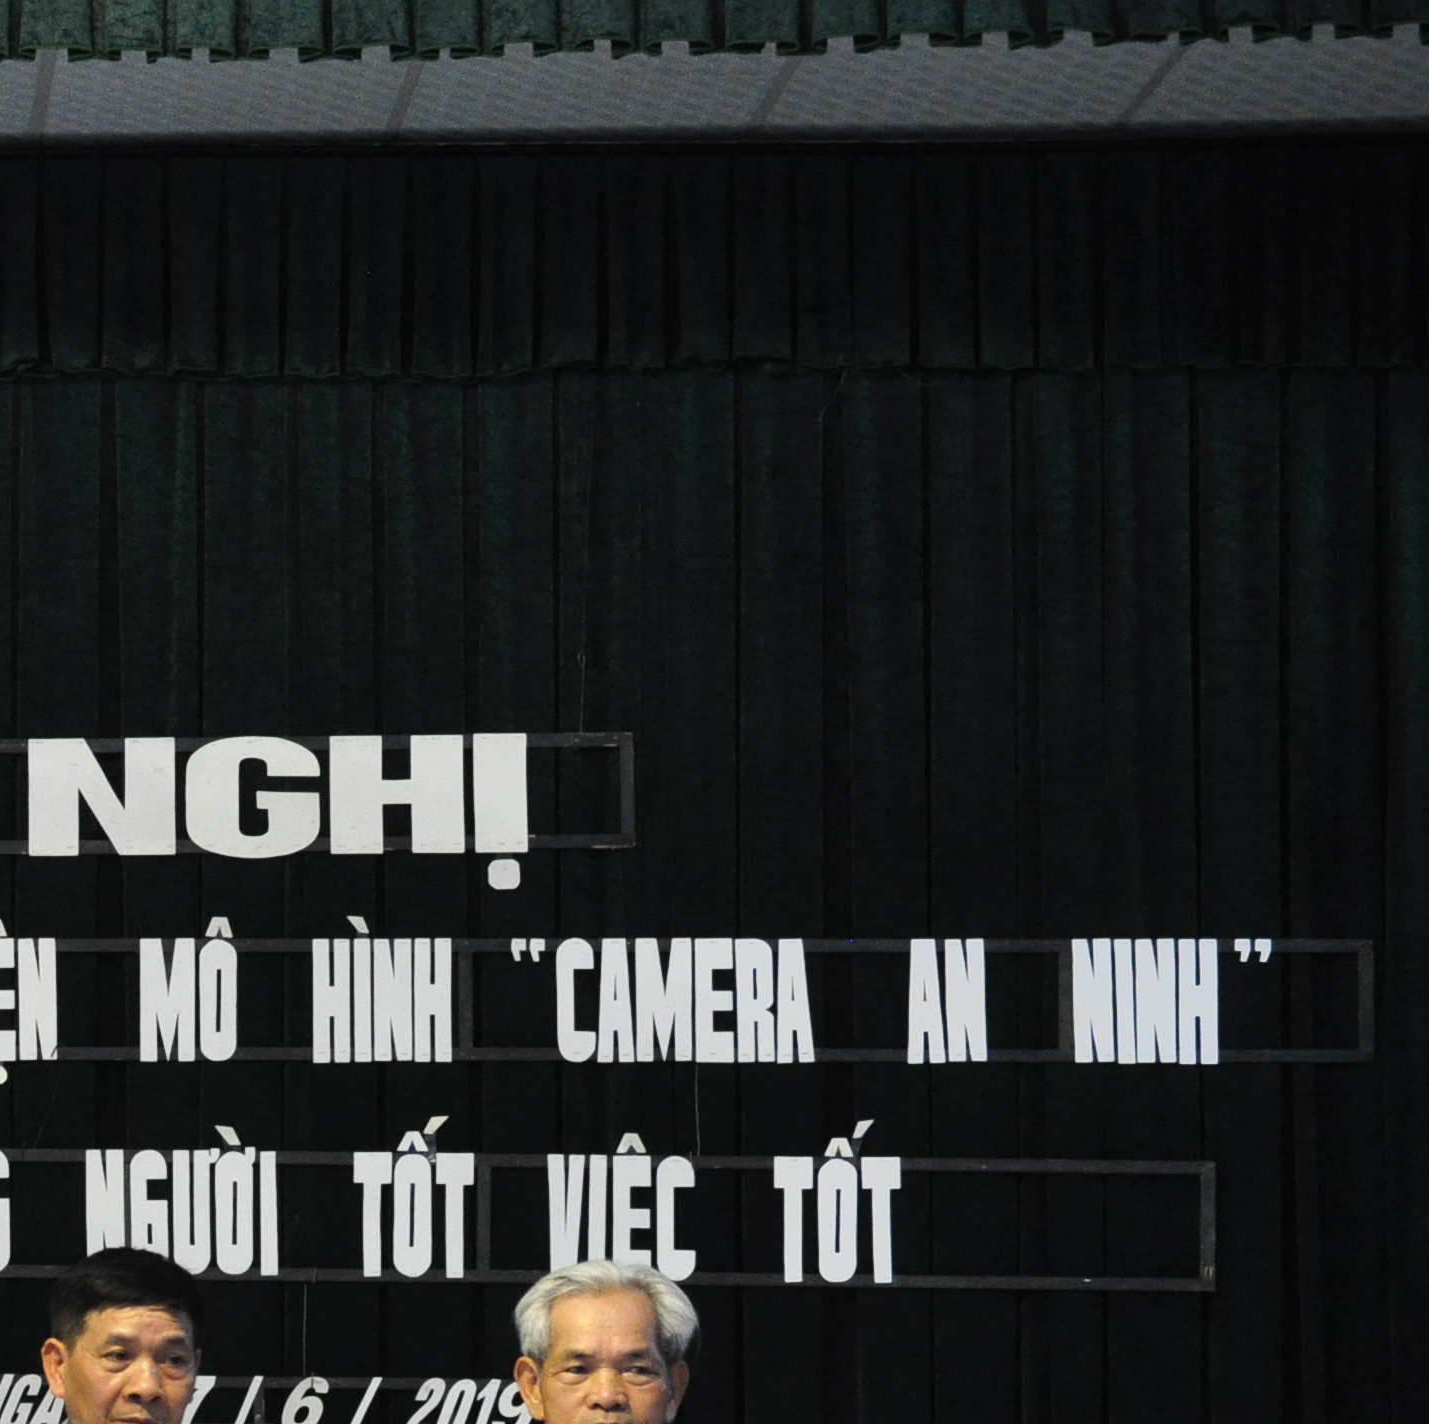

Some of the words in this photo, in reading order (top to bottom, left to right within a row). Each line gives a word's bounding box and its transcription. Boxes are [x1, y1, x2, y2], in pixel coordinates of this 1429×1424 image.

[28, 733, 529, 890] NGHỊ
[140, 917, 239, 1063] MÔ
[312, 916, 453, 1064] HÌNH
[908, 938, 988, 1065] AN
[85, 1126, 279, 1277] NGƯỜI
[354, 1116, 476, 1279] TỐT
[774, 1119, 902, 1284] TỐT
